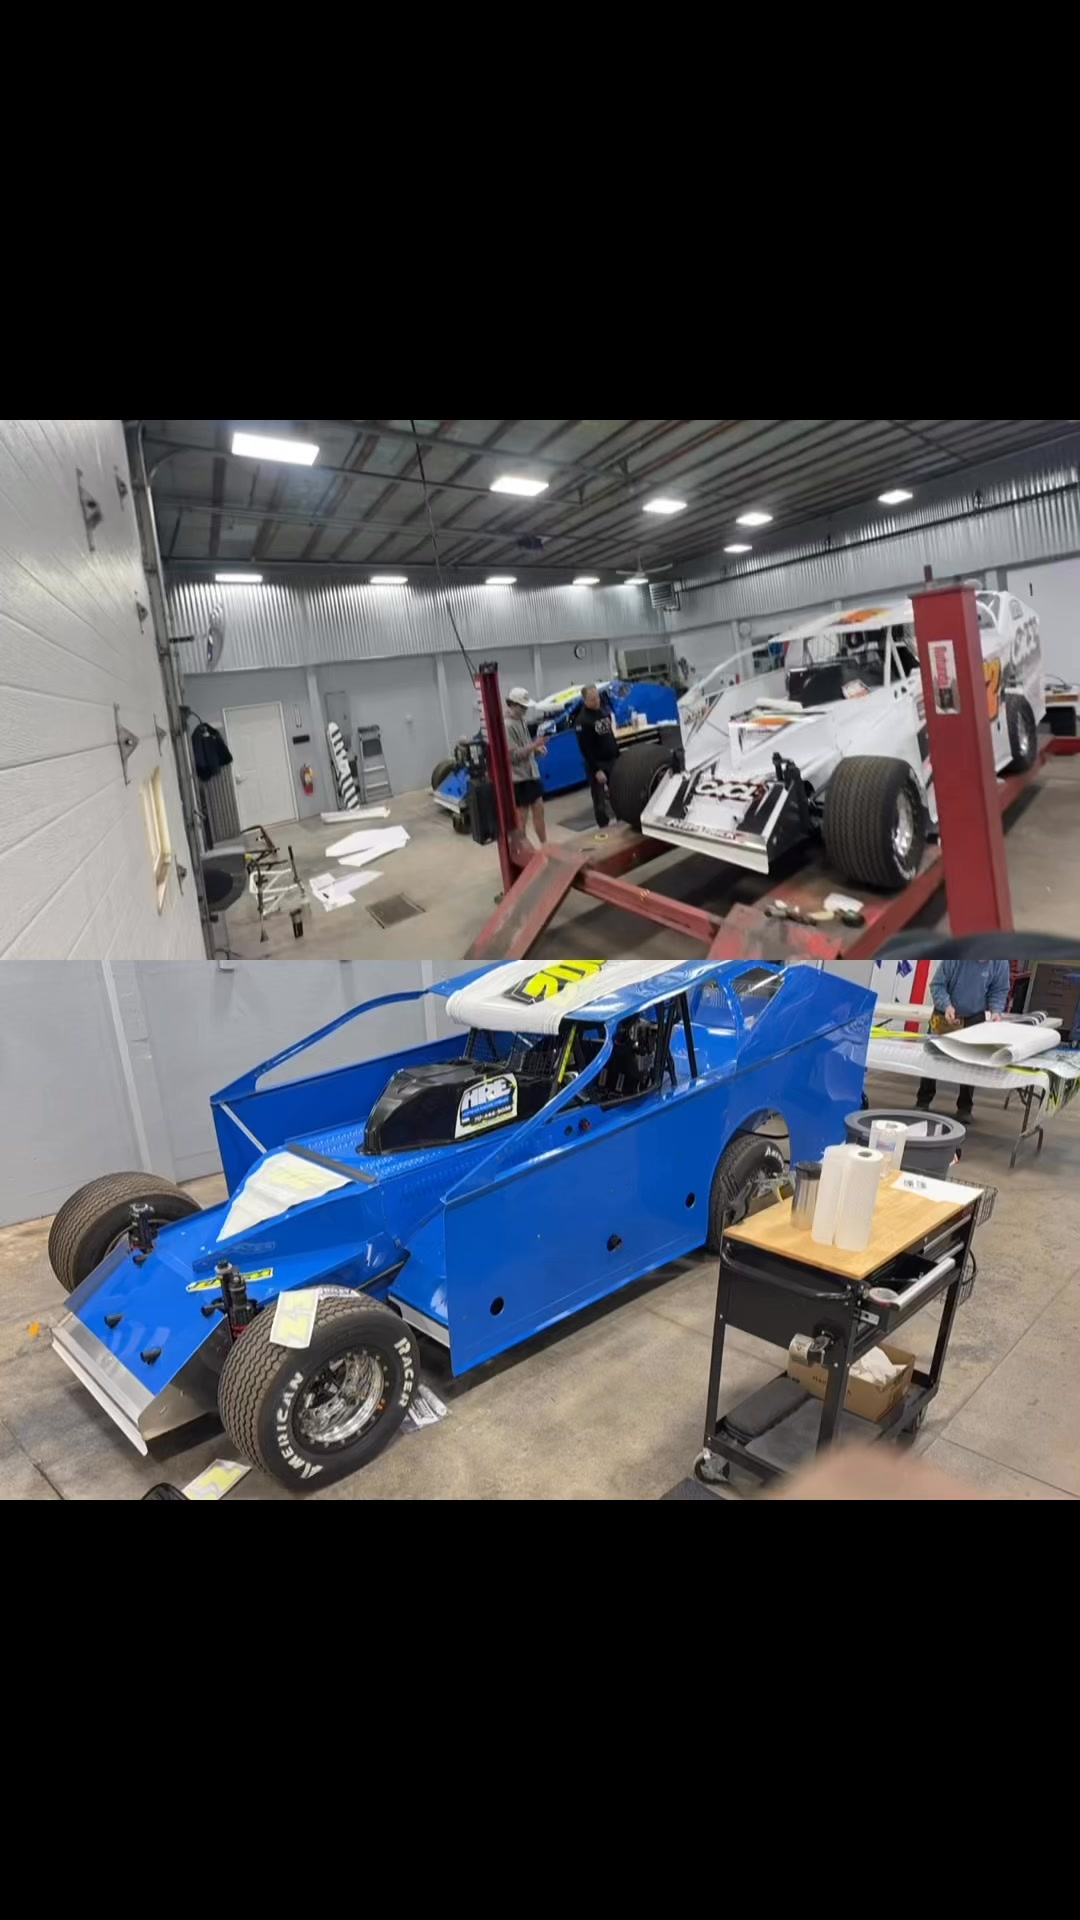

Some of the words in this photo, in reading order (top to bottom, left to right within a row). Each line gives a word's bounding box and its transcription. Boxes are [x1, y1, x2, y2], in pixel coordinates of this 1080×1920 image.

[461, 1078, 513, 1110] HRE
[276, 1371, 324, 1479] AMERICAN
[394, 1337, 414, 1407] RACER
